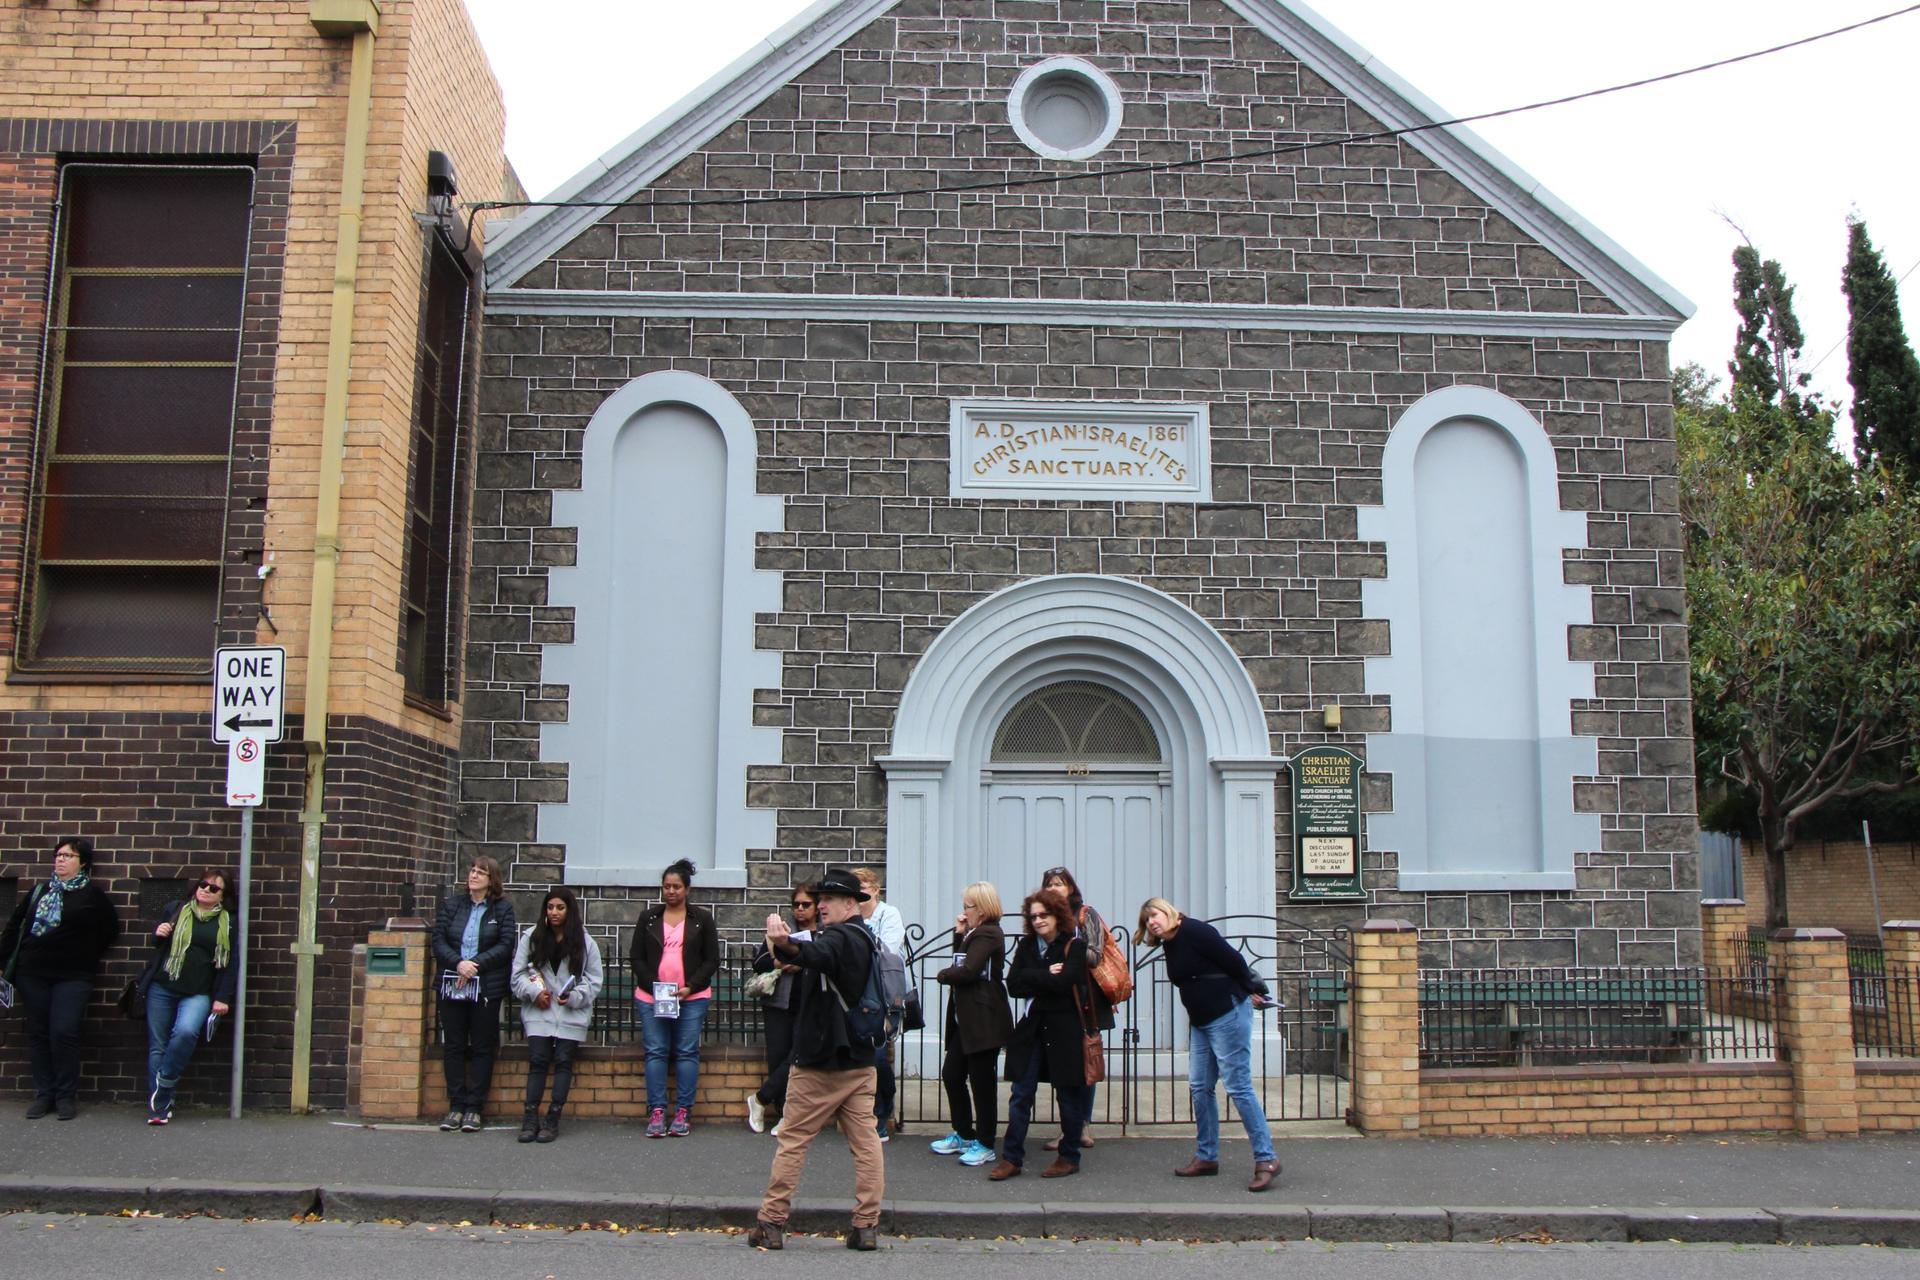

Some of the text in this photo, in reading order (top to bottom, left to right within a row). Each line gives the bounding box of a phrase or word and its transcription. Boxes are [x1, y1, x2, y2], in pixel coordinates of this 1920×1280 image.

[1148, 426, 1185, 442] 1861
[1008, 459, 1154, 478] SANCTUARY.
[227, 657, 273, 679] ONE
[223, 686, 275, 707] WAY
[1301, 756, 1351, 765] CHRISTIAN
[1301, 766, 1351, 776] ISRAELITE
[1302, 776, 1350, 784] SANCTUARY
